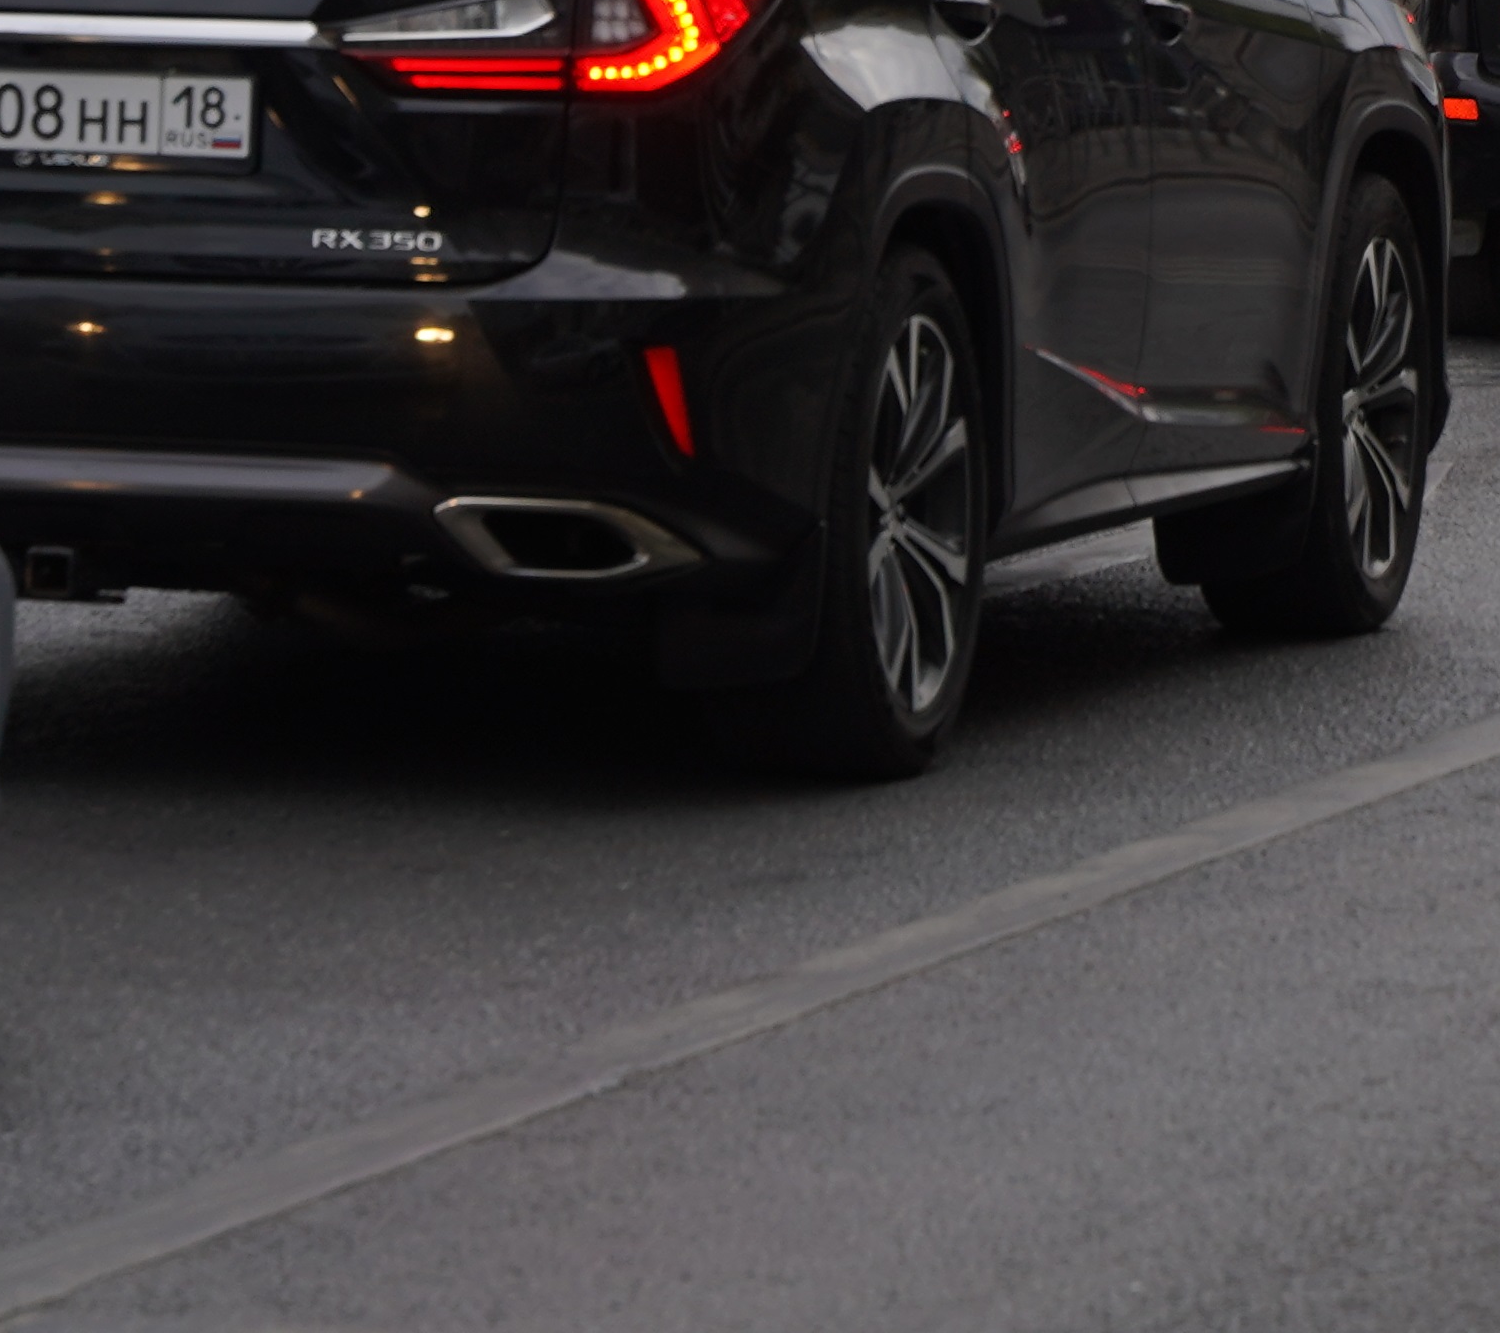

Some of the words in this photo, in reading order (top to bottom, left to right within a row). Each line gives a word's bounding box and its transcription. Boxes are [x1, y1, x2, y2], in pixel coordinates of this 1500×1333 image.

[172, 85, 226, 130] 18
[165, 134, 208, 150] RUS
[311, 228, 365, 250] RX
[368, 229, 444, 252] 350
